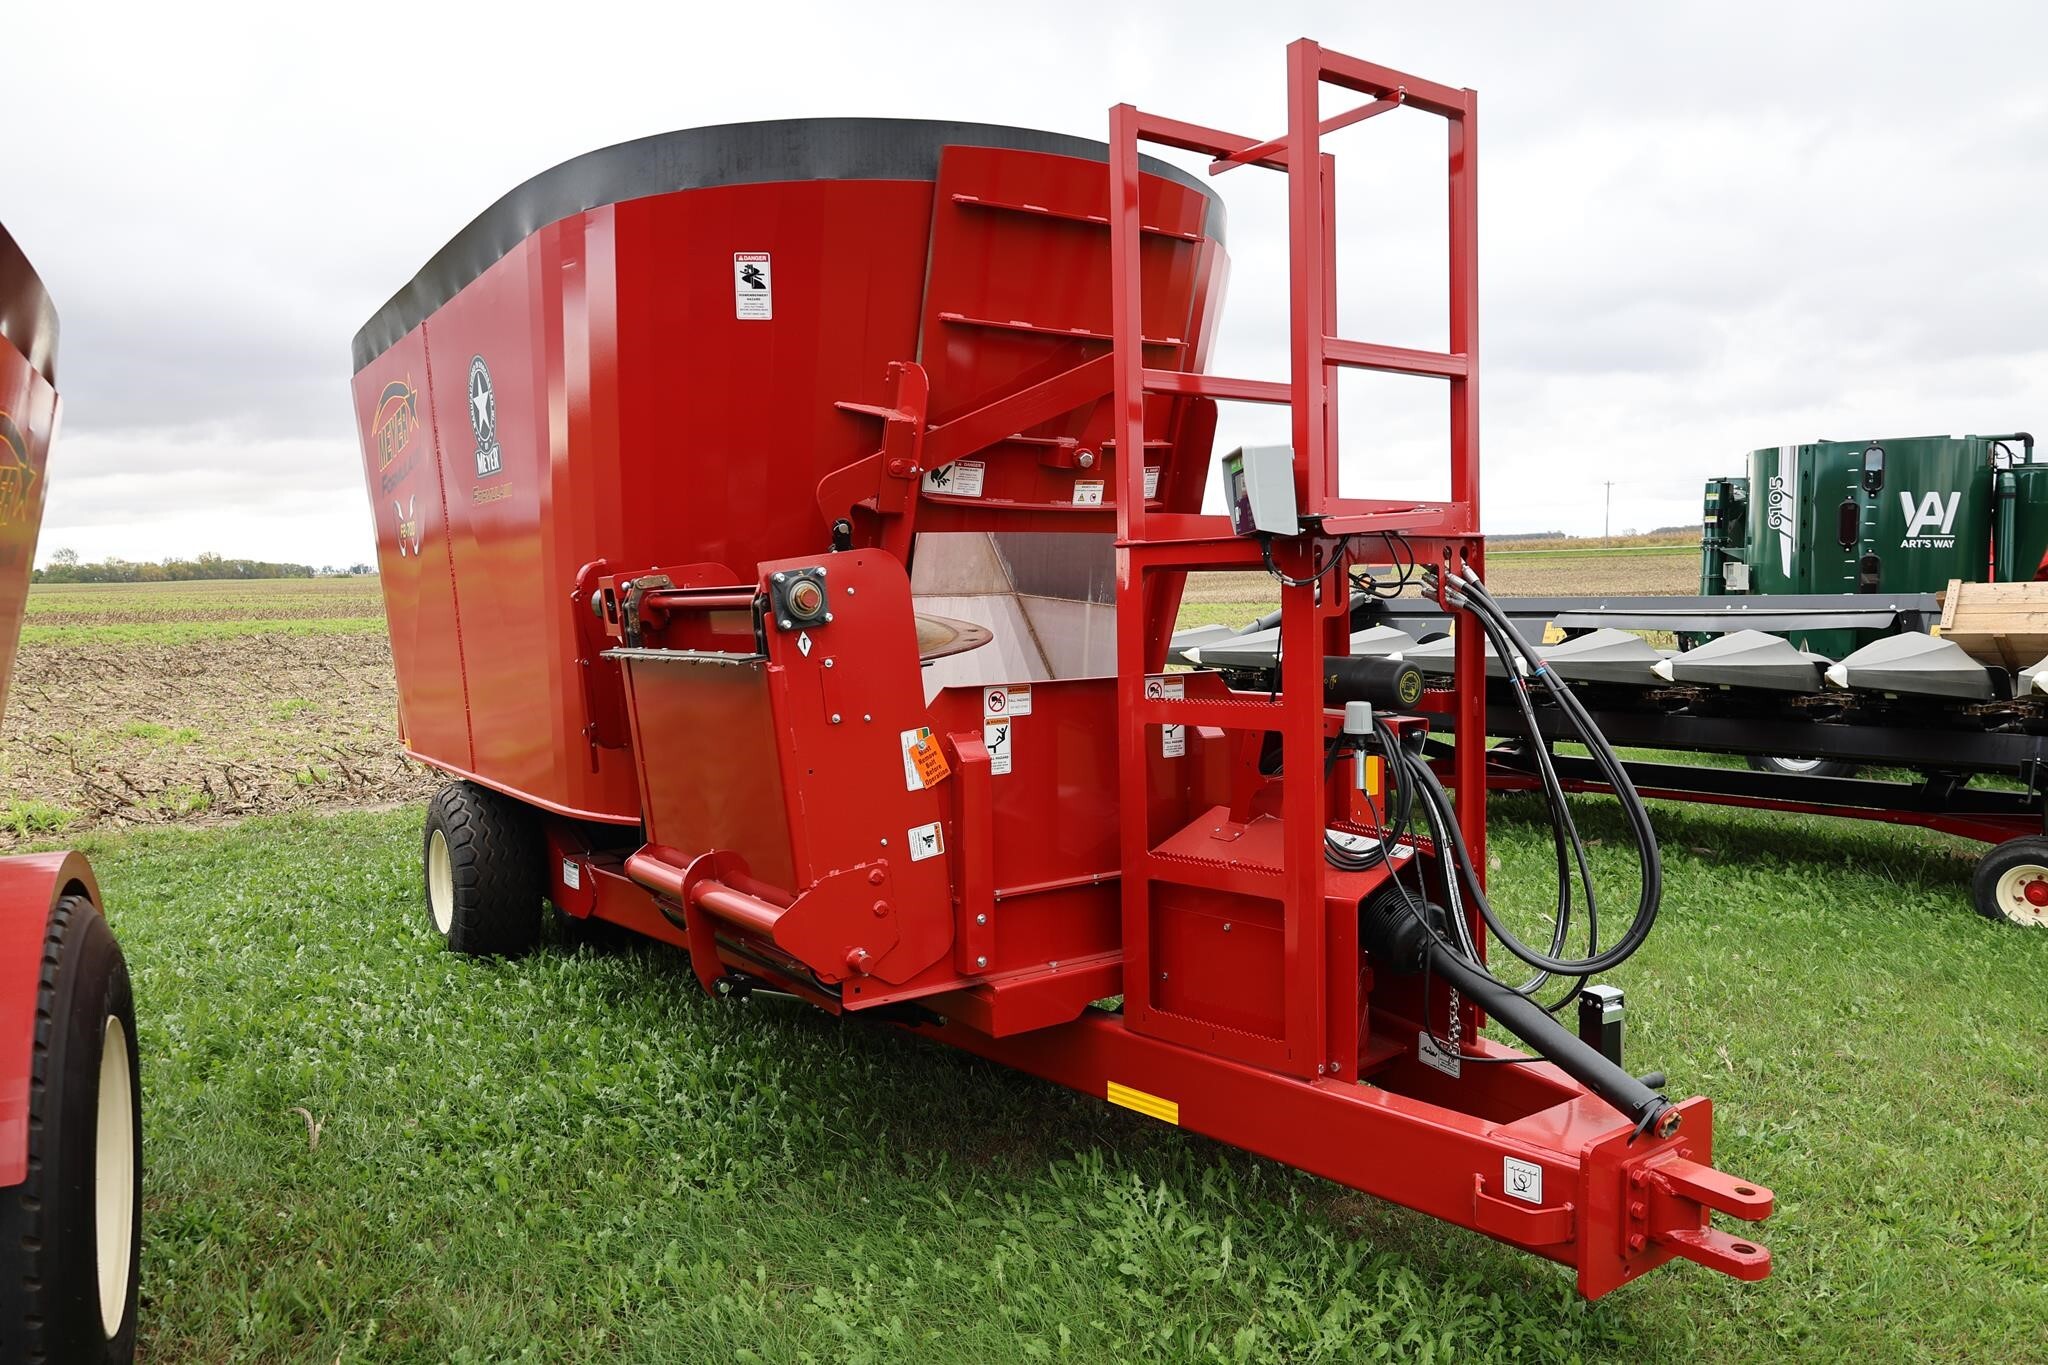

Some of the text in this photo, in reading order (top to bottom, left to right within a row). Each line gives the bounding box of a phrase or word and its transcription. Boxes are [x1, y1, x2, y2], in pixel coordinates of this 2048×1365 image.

[377, 401, 409, 472] MEYER
[476, 445, 500, 475] MEYER
[1768, 475, 1784, 530] 6105
[1900, 539, 1955, 549] ART'S WAY
[918, 750, 938, 765] Remove
[925, 759, 937, 769] Bolt
[925, 764, 943, 778] Before
[925, 768, 949, 786] Operation
